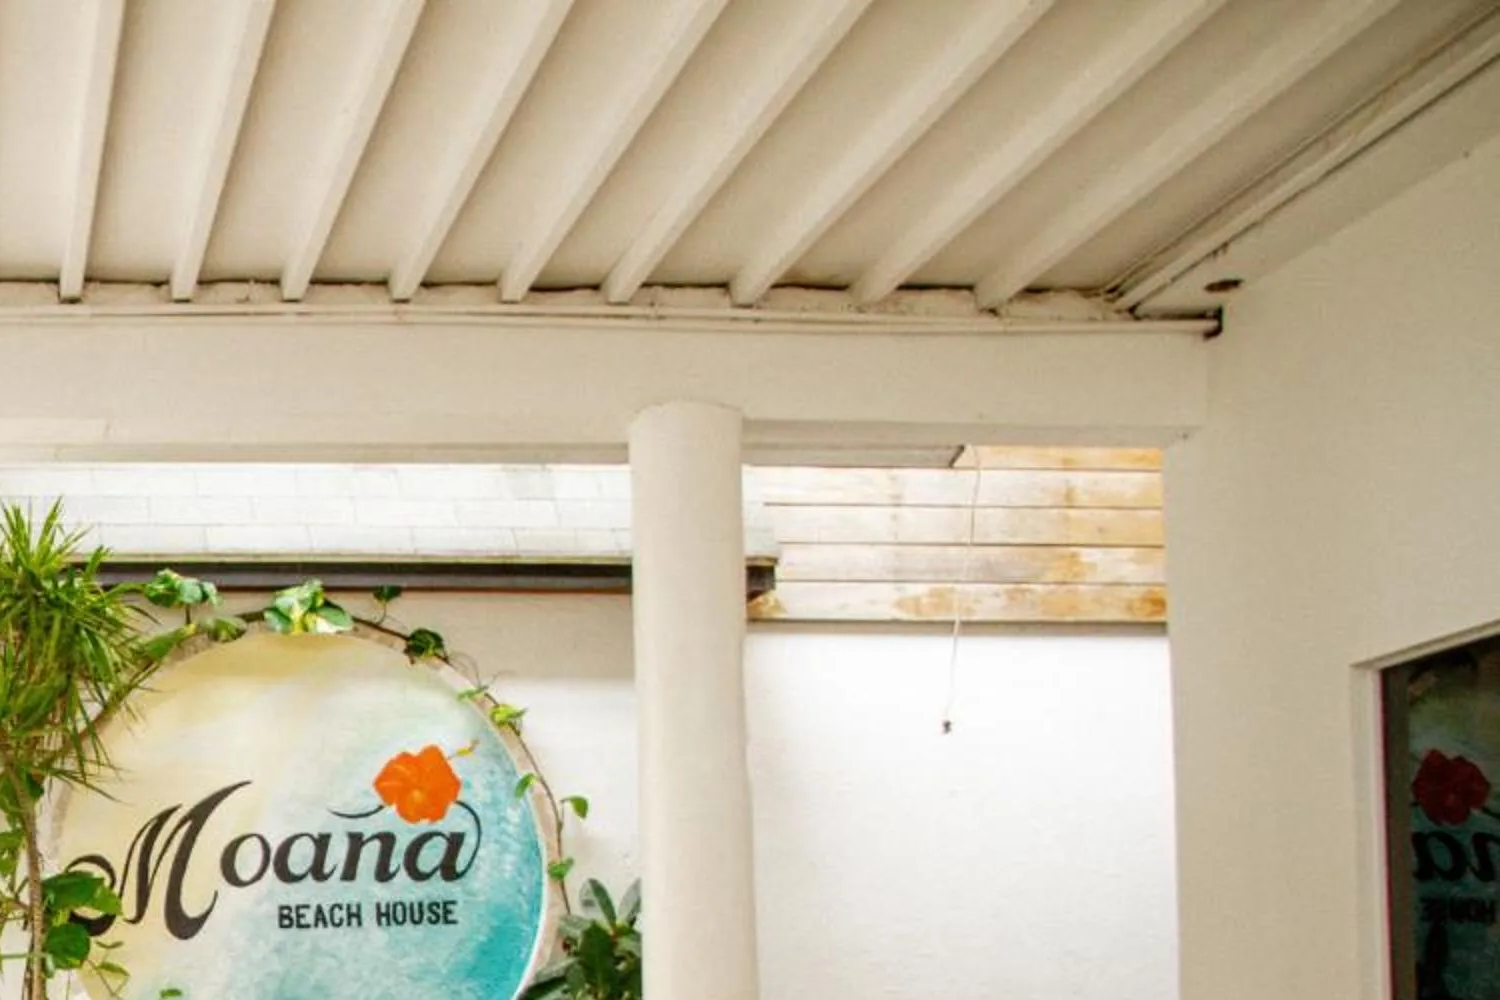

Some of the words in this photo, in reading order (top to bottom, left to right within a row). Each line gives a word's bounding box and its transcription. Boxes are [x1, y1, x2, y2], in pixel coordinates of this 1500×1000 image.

[64, 780, 482, 940] Moana
[278, 903, 363, 929] BEACH
[375, 900, 459, 926] HOUSE
